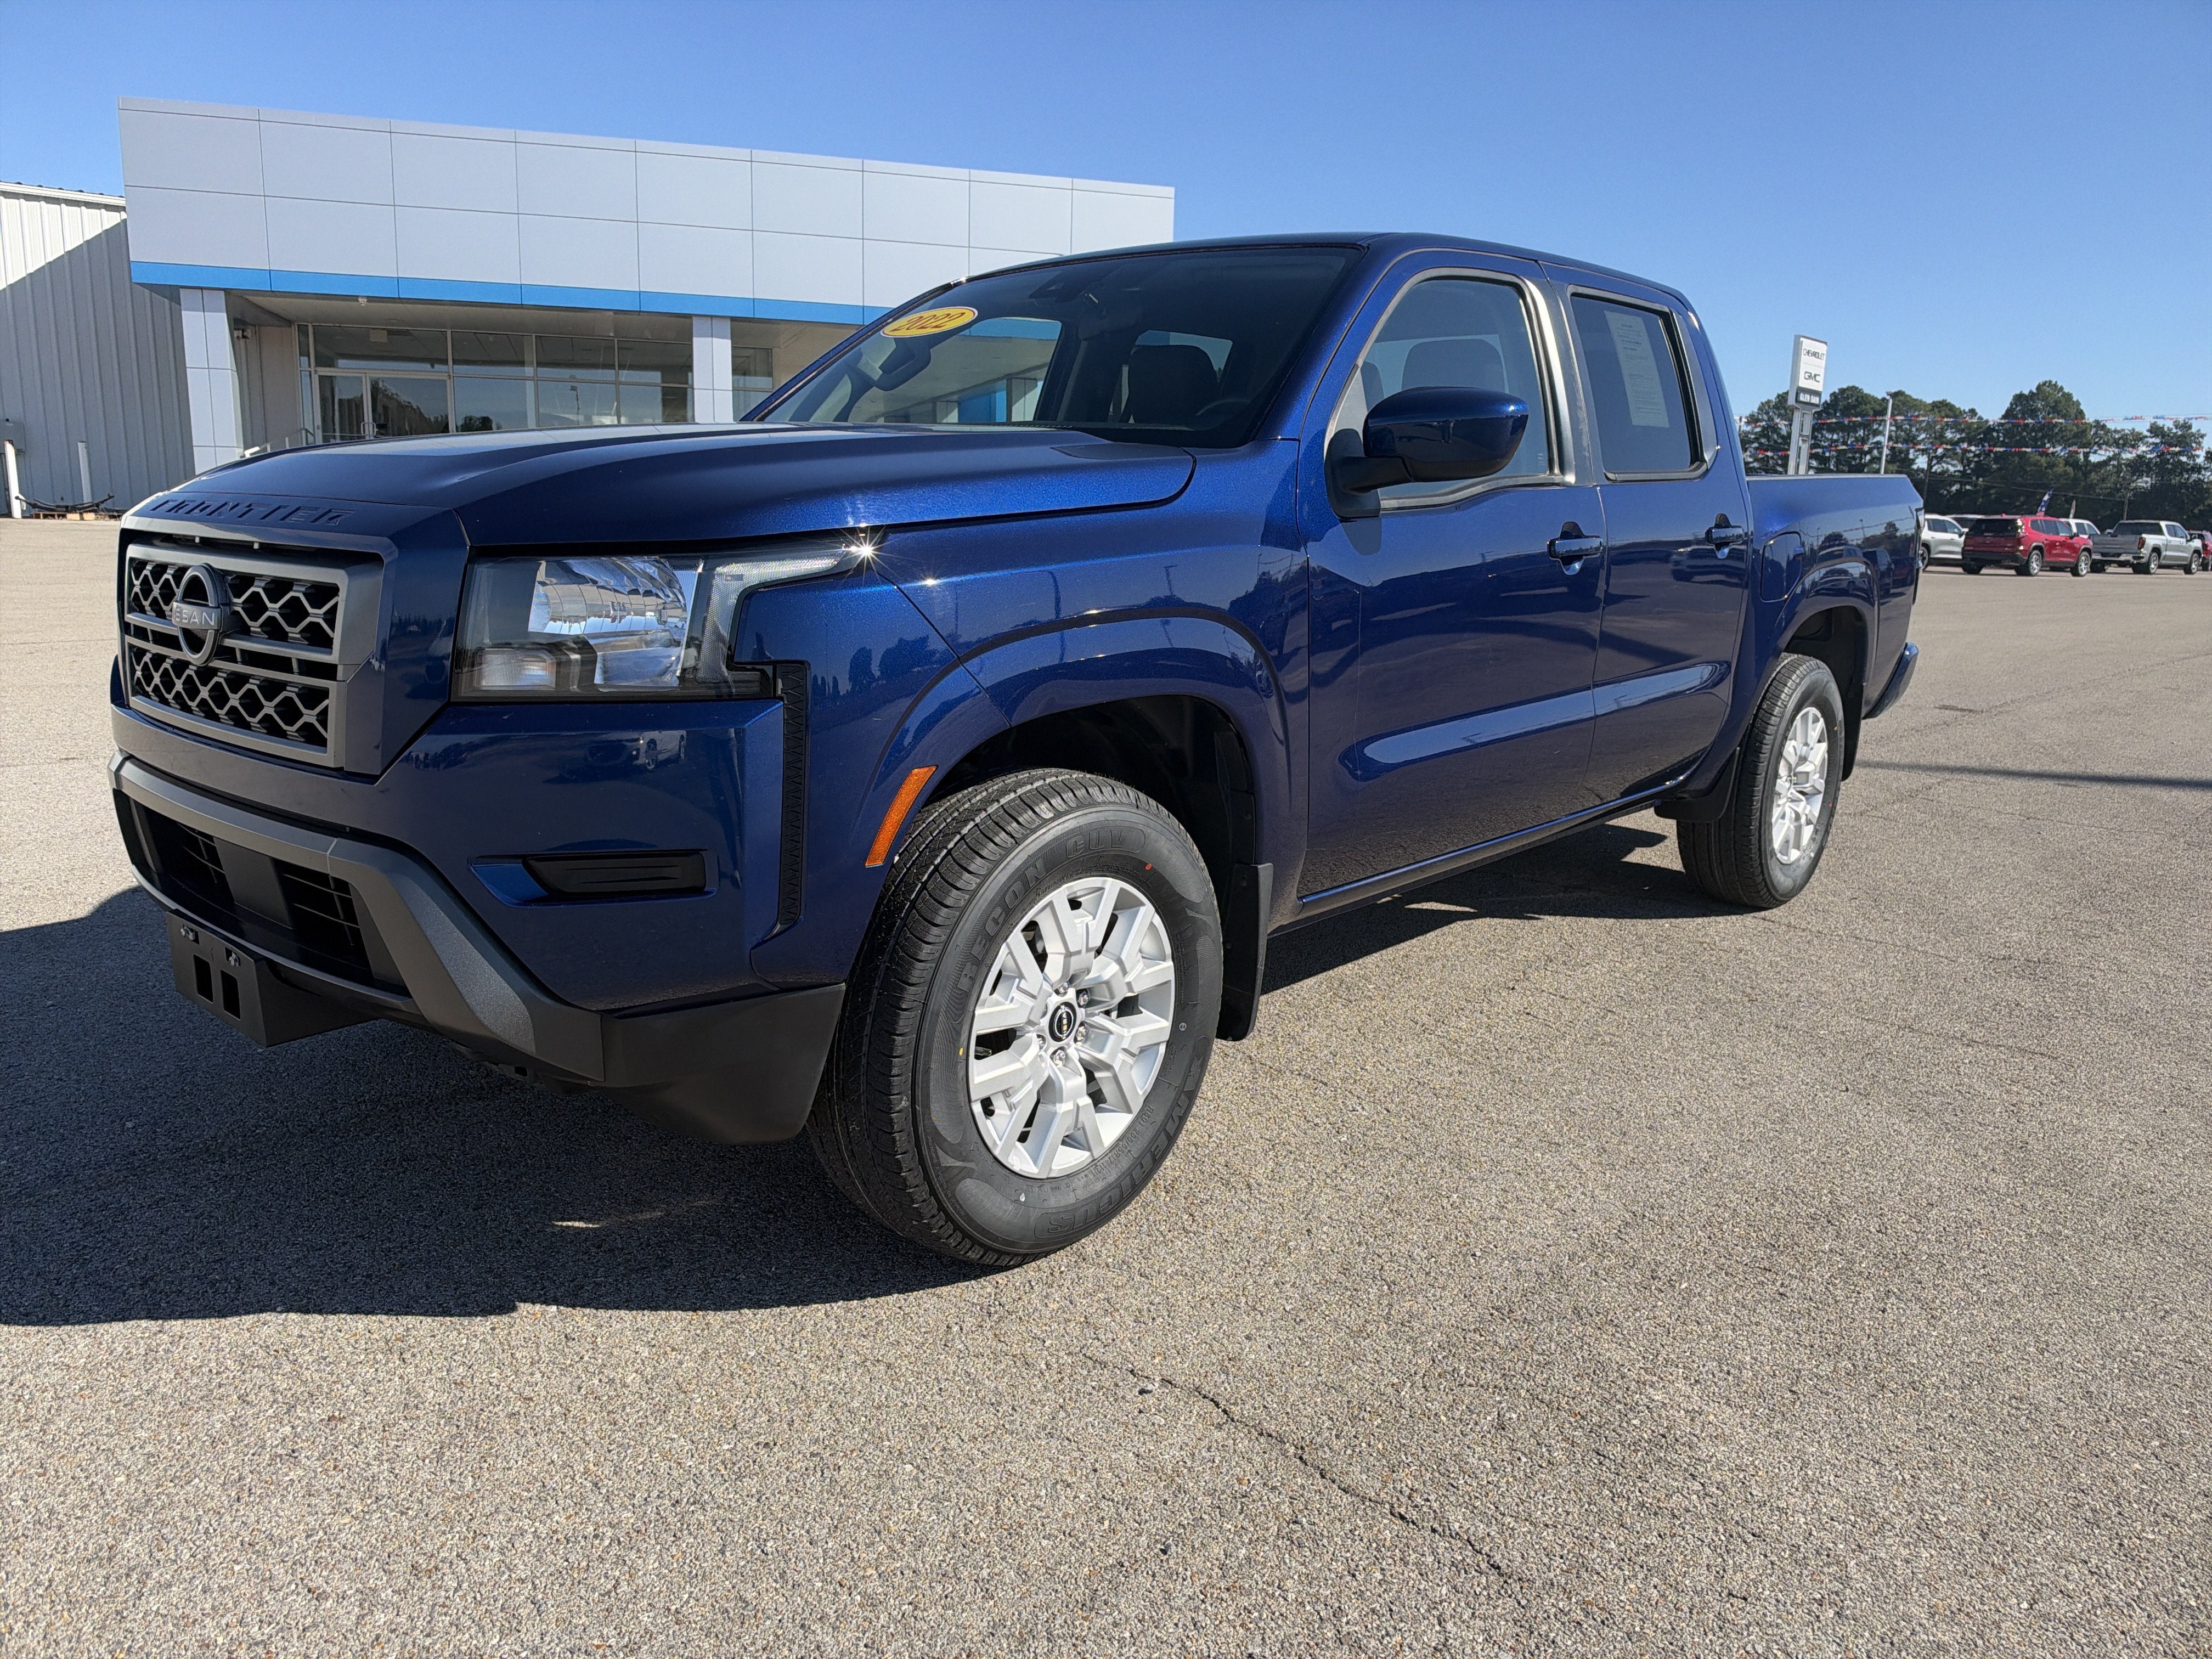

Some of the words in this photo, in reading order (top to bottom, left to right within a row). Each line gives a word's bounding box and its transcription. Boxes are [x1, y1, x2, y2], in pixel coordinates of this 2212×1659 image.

[889, 312, 966, 332] 2022
[1803, 348, 1825, 360] CHEVROLET
[1804, 371, 1821, 383] GMC
[150, 499, 355, 526] FRONTIER
[172, 606, 215, 625] SSAN
[957, 857, 1047, 992] RECON
[1066, 828, 1128, 859] CUV
